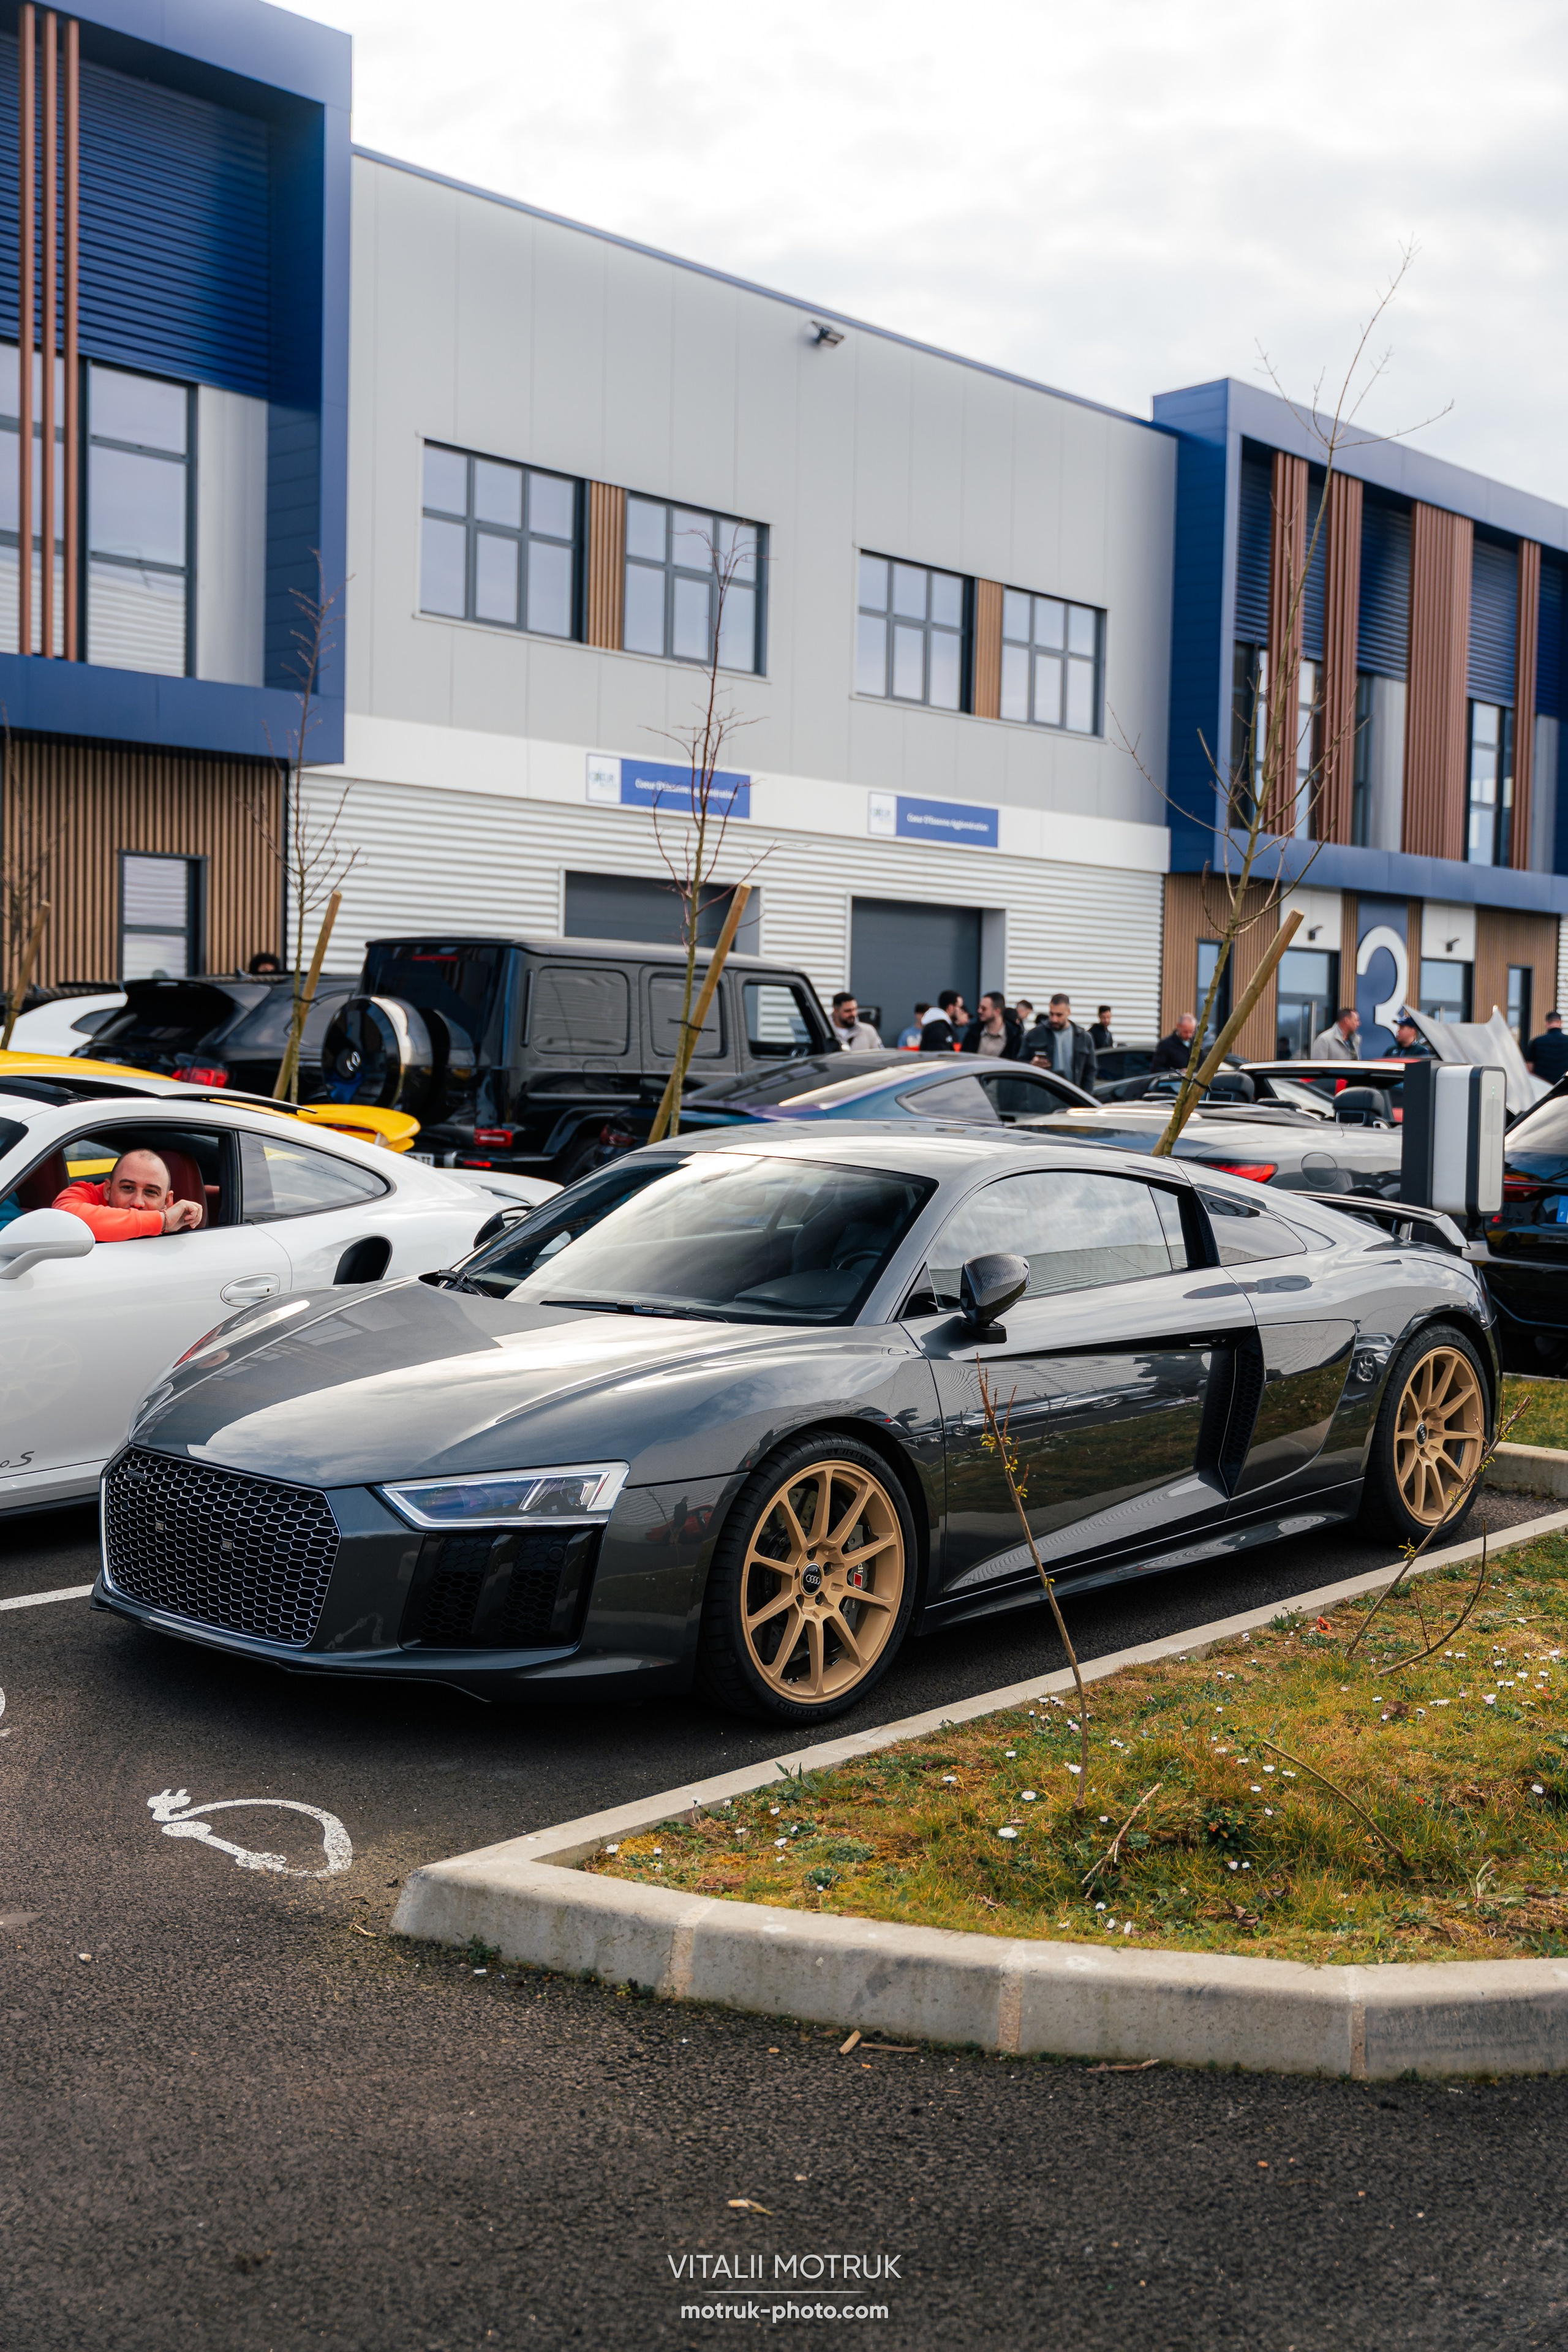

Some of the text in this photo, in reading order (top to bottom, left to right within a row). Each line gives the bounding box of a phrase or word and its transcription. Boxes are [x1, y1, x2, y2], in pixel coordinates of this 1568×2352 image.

[1357, 925, 1408, 1040] 3
[9, 1451, 35, 1468] S
[837, 1449, 875, 1466] MICHELIN
[779, 1703, 818, 1716] MICHELIN
